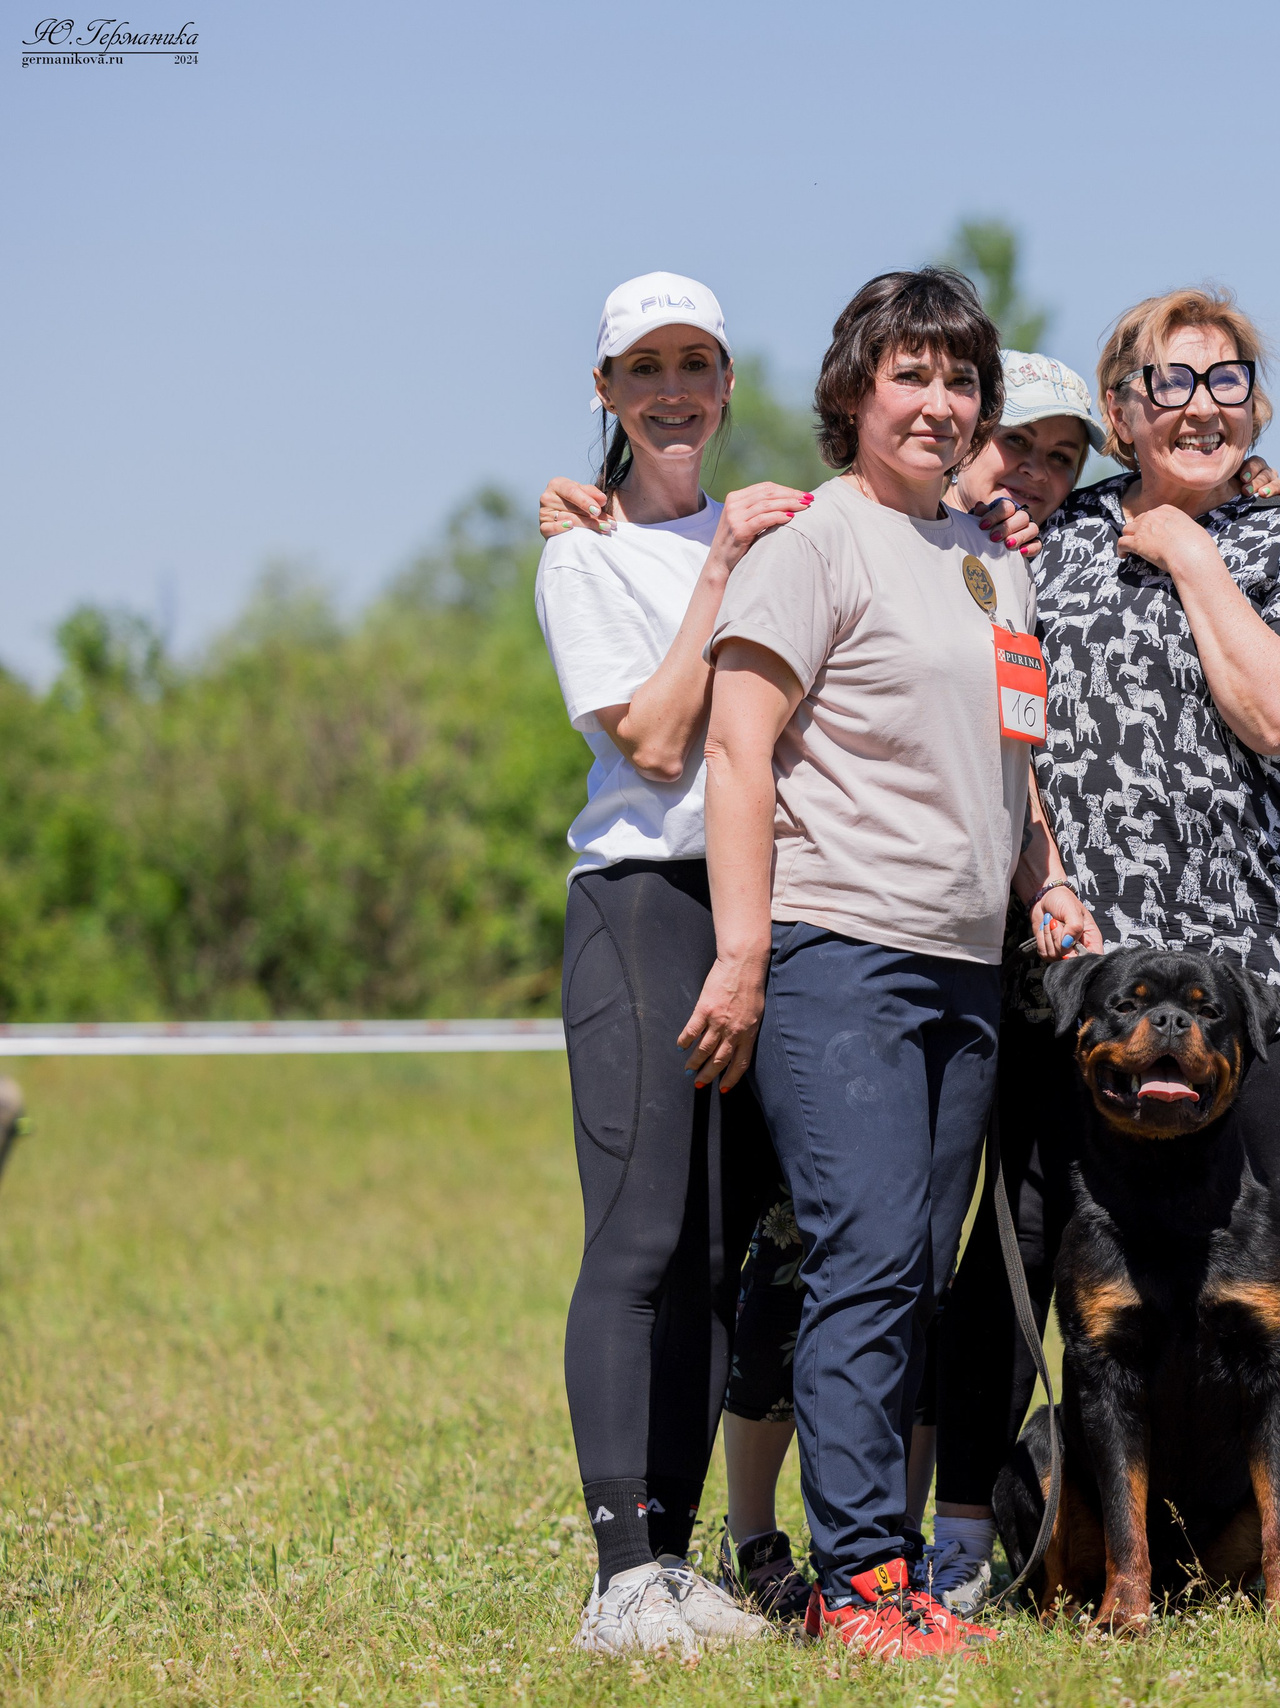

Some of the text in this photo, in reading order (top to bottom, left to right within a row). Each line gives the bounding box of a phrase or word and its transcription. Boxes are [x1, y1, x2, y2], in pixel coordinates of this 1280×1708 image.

[640, 293, 696, 313] FILA
[1005, 652, 1041, 670] PURINA
[1011, 693, 1036, 728] 16
